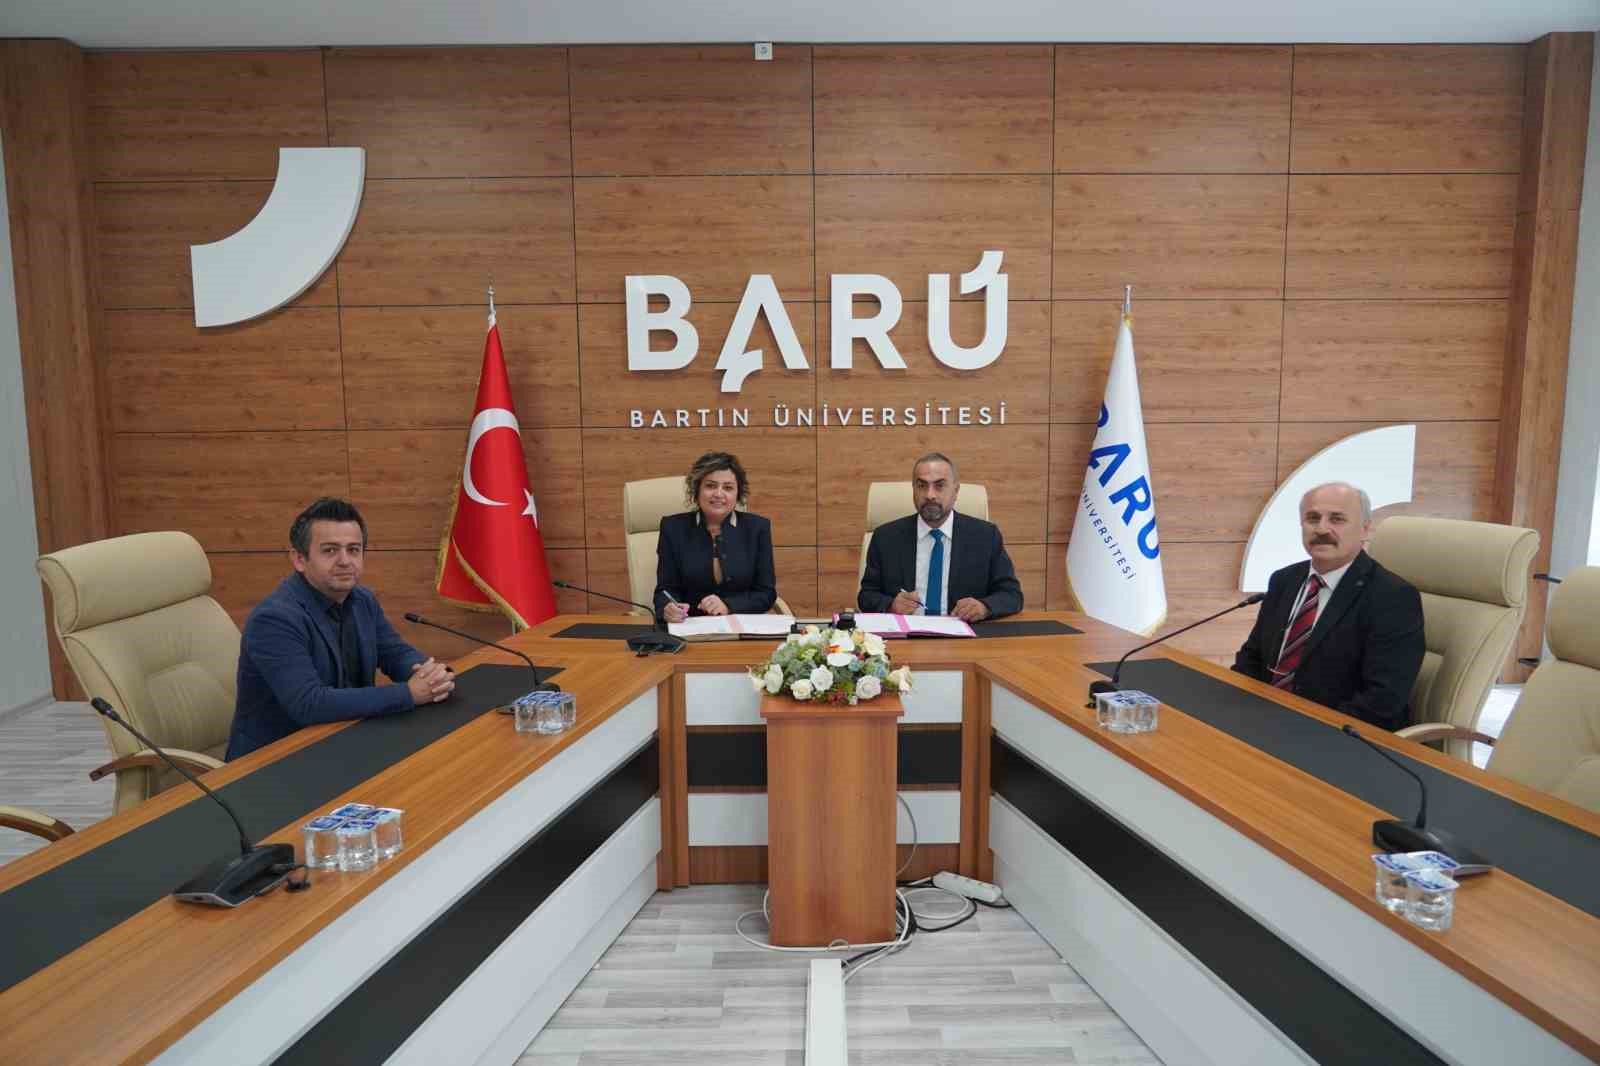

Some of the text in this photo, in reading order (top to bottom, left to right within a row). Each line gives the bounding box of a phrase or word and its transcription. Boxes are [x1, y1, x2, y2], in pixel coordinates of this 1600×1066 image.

[630, 402, 1008, 428] BARTIN ÜNİVERSİTESİ
[1081, 488, 1136, 581] NİVERSİTESİ
